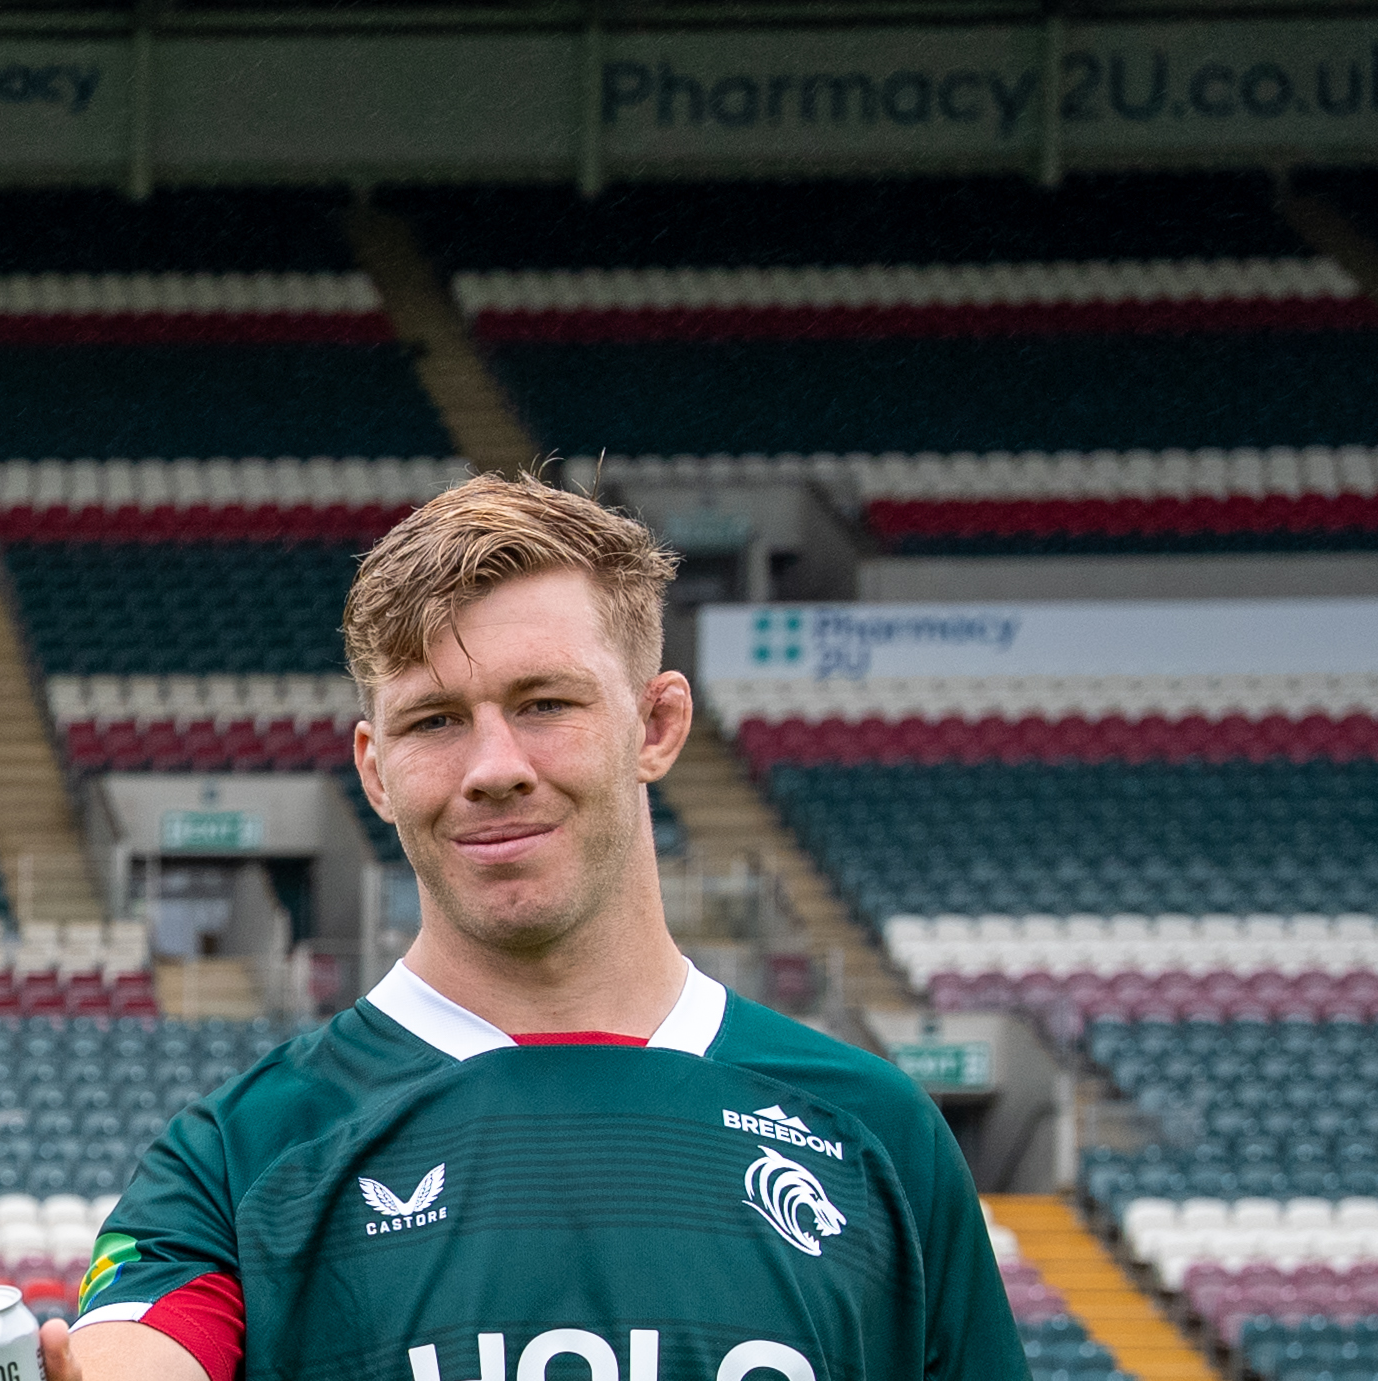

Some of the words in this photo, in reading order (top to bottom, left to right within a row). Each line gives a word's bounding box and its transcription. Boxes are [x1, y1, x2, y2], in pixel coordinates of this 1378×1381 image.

[601, 42, 1378, 141] Pharmacy2U.co.u
[722, 1109, 843, 1160] BREEDON
[366, 1206, 448, 1236] CASTORE
